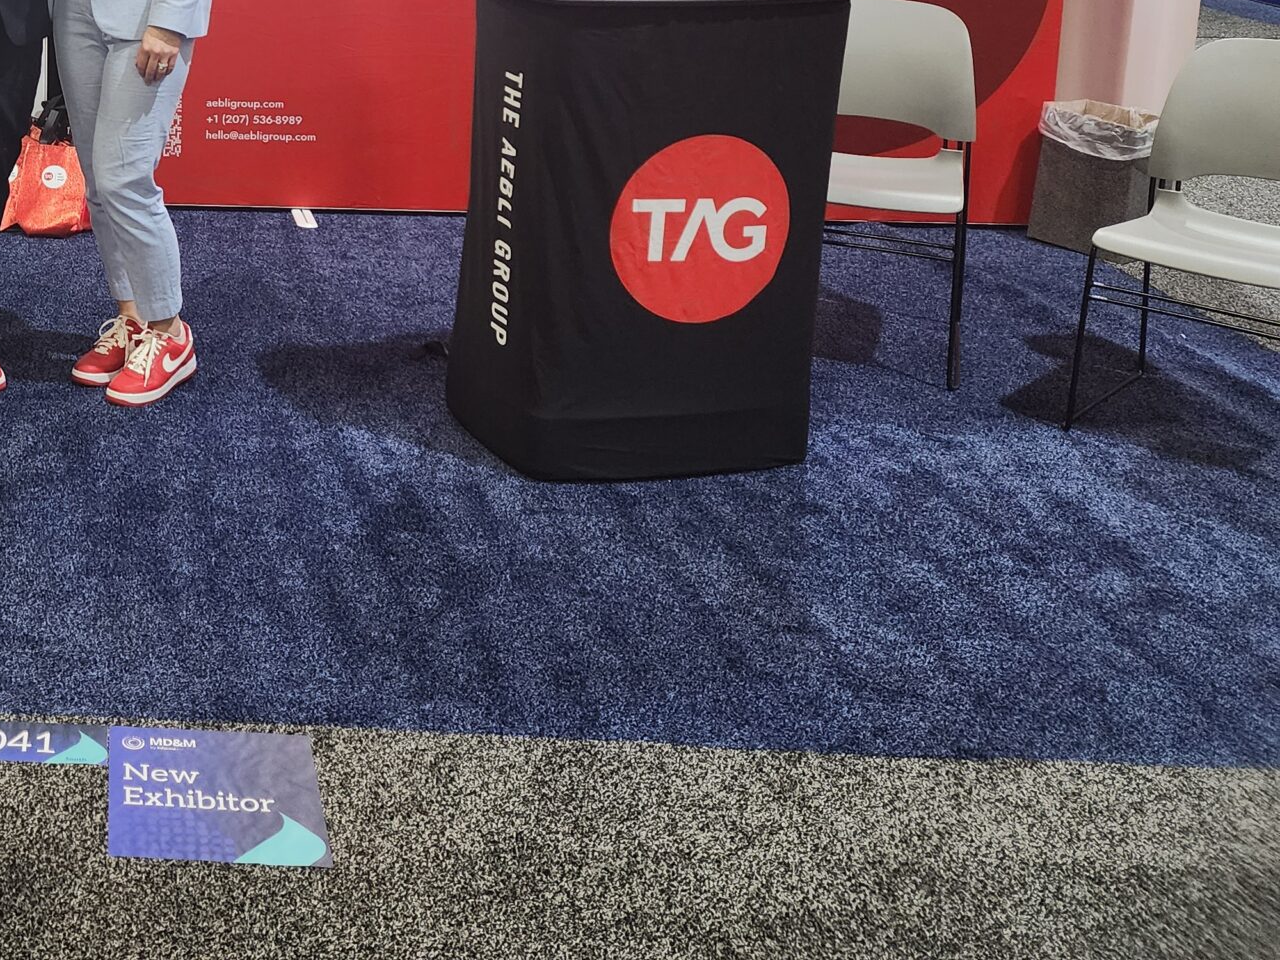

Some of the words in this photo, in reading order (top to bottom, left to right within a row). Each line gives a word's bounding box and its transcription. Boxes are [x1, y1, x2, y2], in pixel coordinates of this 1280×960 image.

[206, 98, 284, 110] aebligroup.com
[502, 70, 524, 128] THE
[206, 115, 219, 124] +1
[222, 114, 250, 126] (207)
[252, 114, 303, 126] 536-8989
[205, 129, 317, 143] hello@aebligroup.com
[495, 137, 518, 229] AEBLI
[631, 196, 768, 263] TAG
[489, 239, 513, 346] GROUP
[149, 737, 197, 748] MD&M
[122, 762, 200, 785] New
[122, 786, 276, 813] Exhibitor
